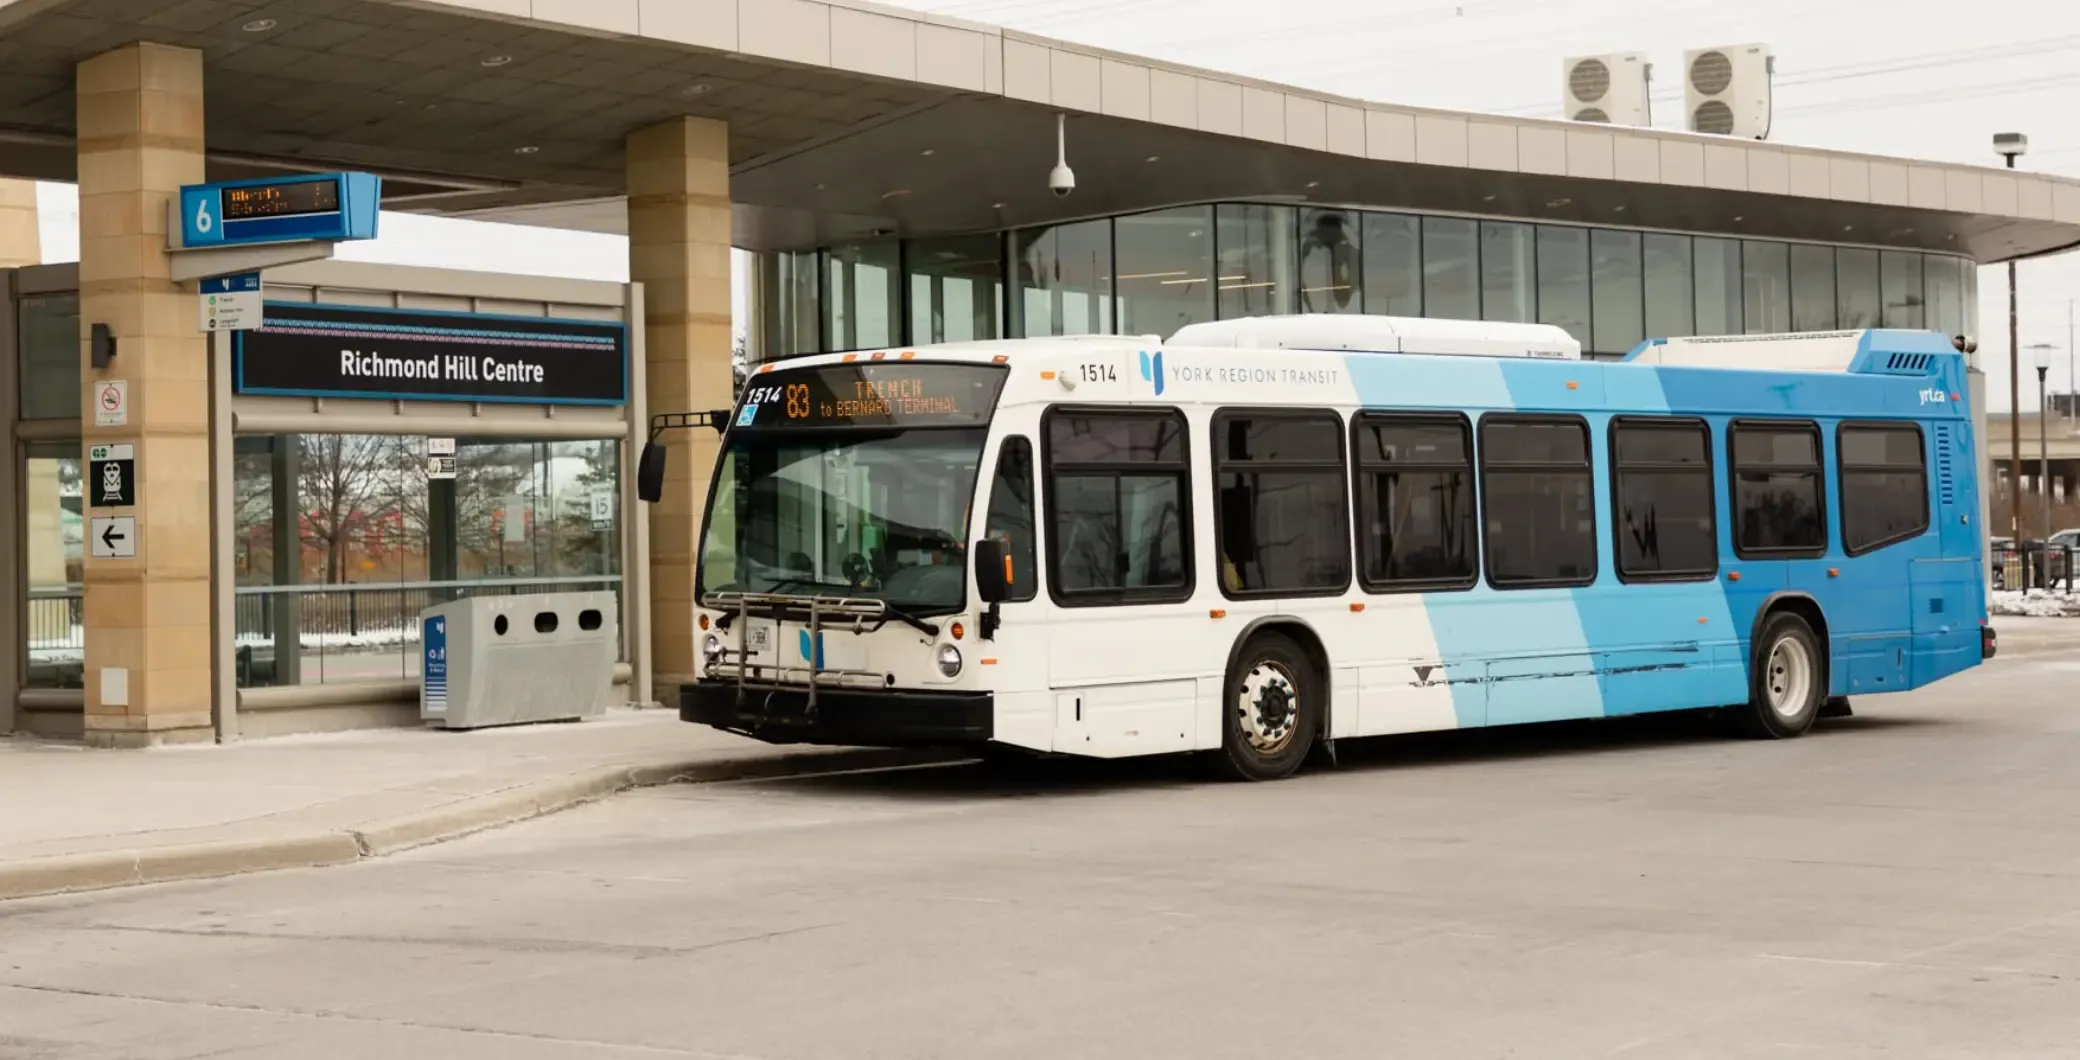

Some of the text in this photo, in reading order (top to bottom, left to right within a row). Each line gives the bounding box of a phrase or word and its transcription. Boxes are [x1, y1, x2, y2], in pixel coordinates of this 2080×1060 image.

[196, 200, 212, 233] 6
[341, 350, 544, 383] Richmond Hill Centre
[1080, 364, 1117, 383] 1514
[1173, 367, 1338, 385] YORK REGION TRANSIT
[747, 386, 782, 404] 1514
[786, 384, 809, 418] 83
[1919, 388, 1945, 406] yrt.ca
[820, 397, 960, 417] to BERNARD TERMINAL
[92, 447, 107, 459] GO
